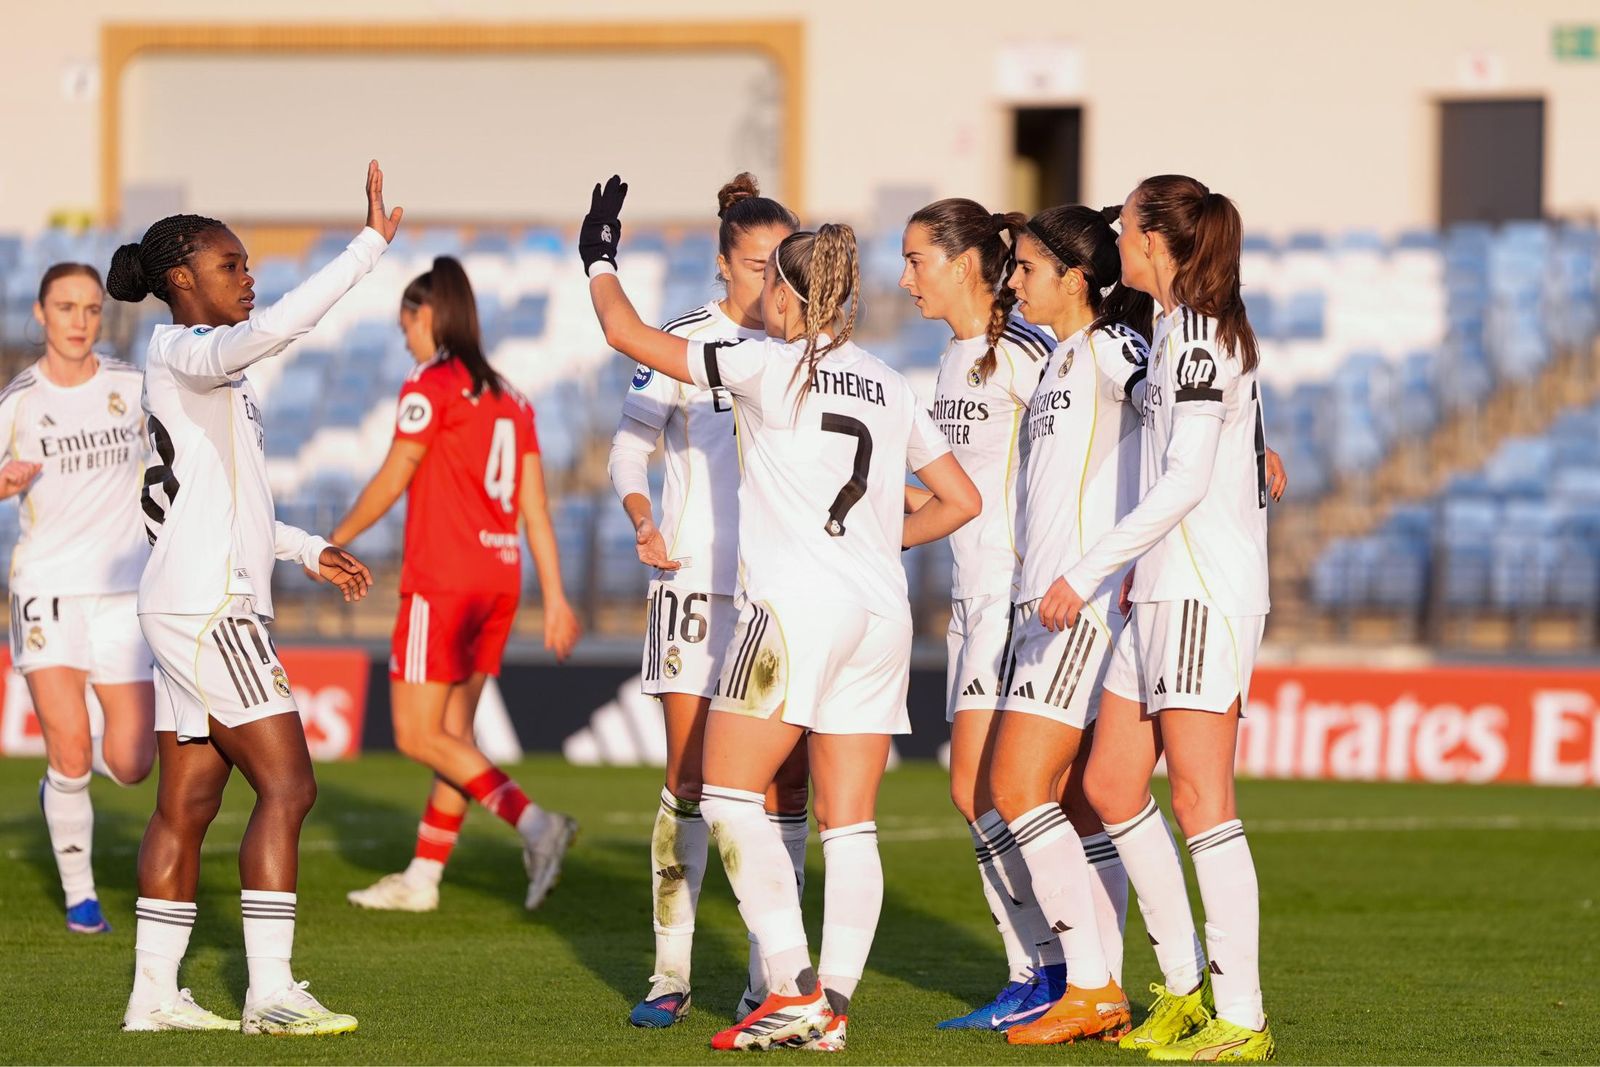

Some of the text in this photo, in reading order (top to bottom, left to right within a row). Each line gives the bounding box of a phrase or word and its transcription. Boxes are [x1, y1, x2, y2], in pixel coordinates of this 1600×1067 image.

[811, 370, 886, 407] ATHENEA
[1180, 349, 1214, 388] hp
[41, 425, 137, 457] Emirates
[61, 446, 129, 475] FLY BETTER
[484, 418, 516, 513] 4
[821, 412, 873, 537] 7
[236, 617, 277, 665] 1
[665, 590, 708, 644] 16
[1530, 689, 1600, 786] E
